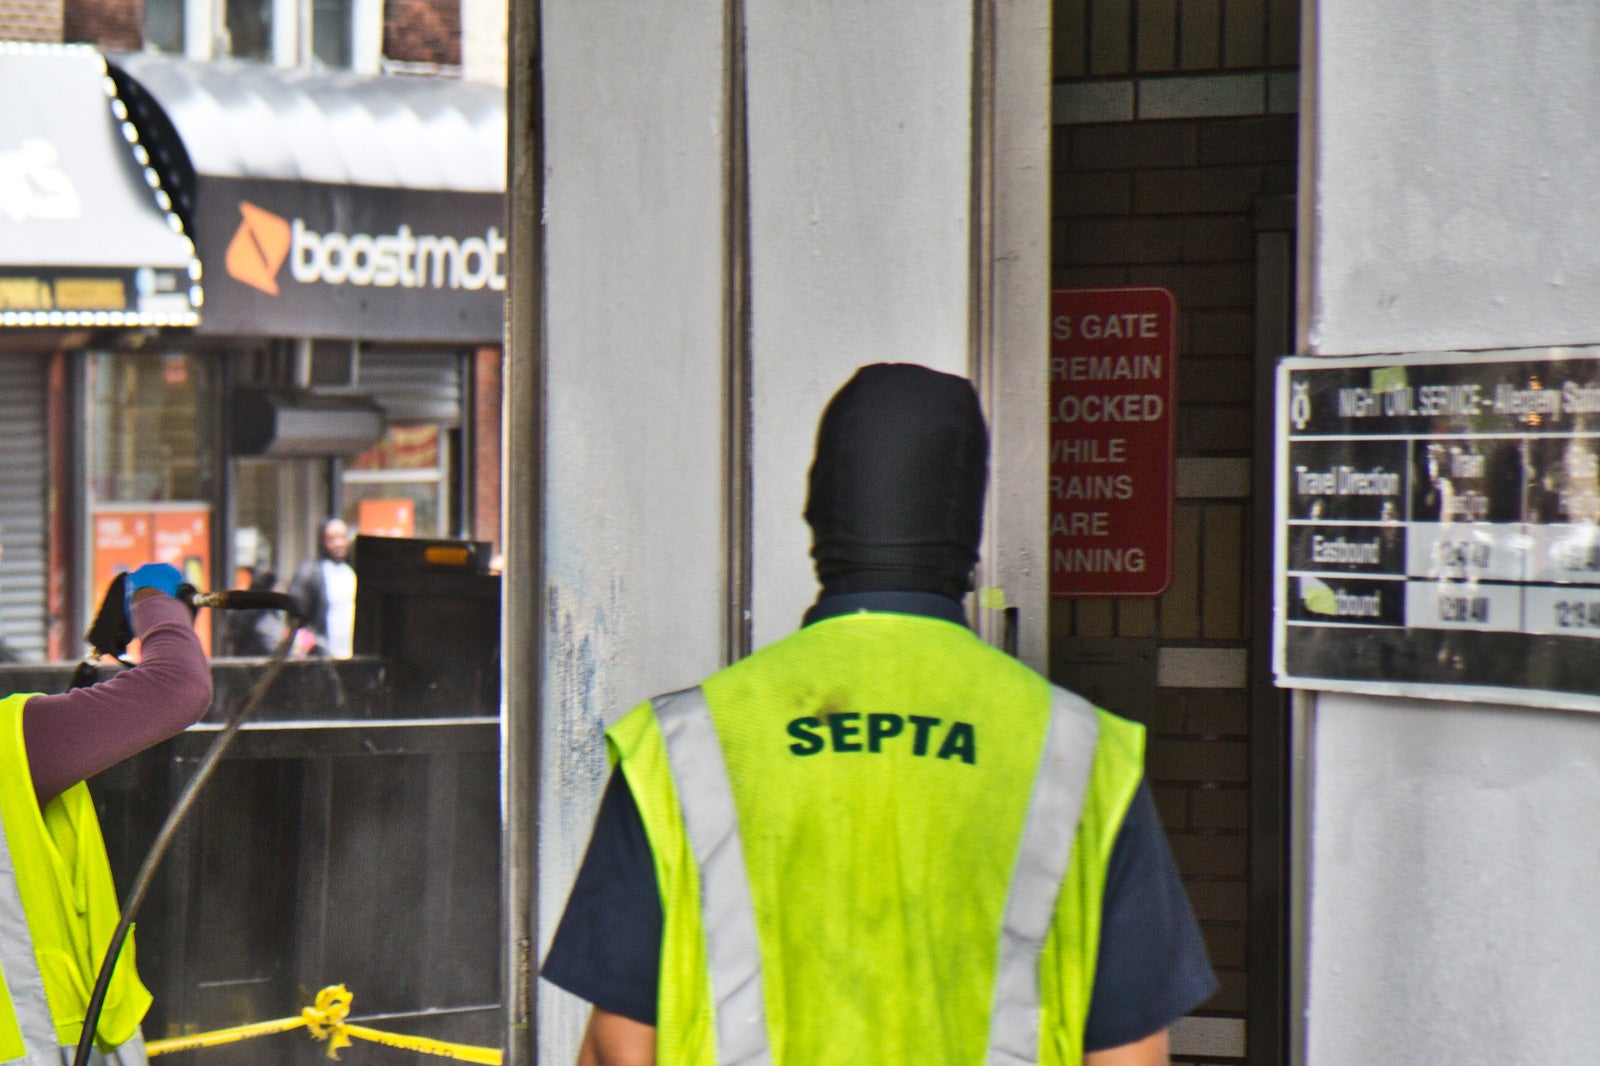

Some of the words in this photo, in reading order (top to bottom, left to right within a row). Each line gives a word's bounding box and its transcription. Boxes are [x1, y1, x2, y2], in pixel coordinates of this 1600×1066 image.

[1080, 314, 1158, 339] GATE
[1050, 355, 1162, 381] REMAIN
[1296, 465, 1337, 496] Travel
[1338, 465, 1400, 496] Direction
[1051, 511, 1109, 536] ARE
[1053, 548, 1145, 573] NNING
[1312, 535, 1380, 564] Eastbound
[786, 712, 977, 765] SEPTA
